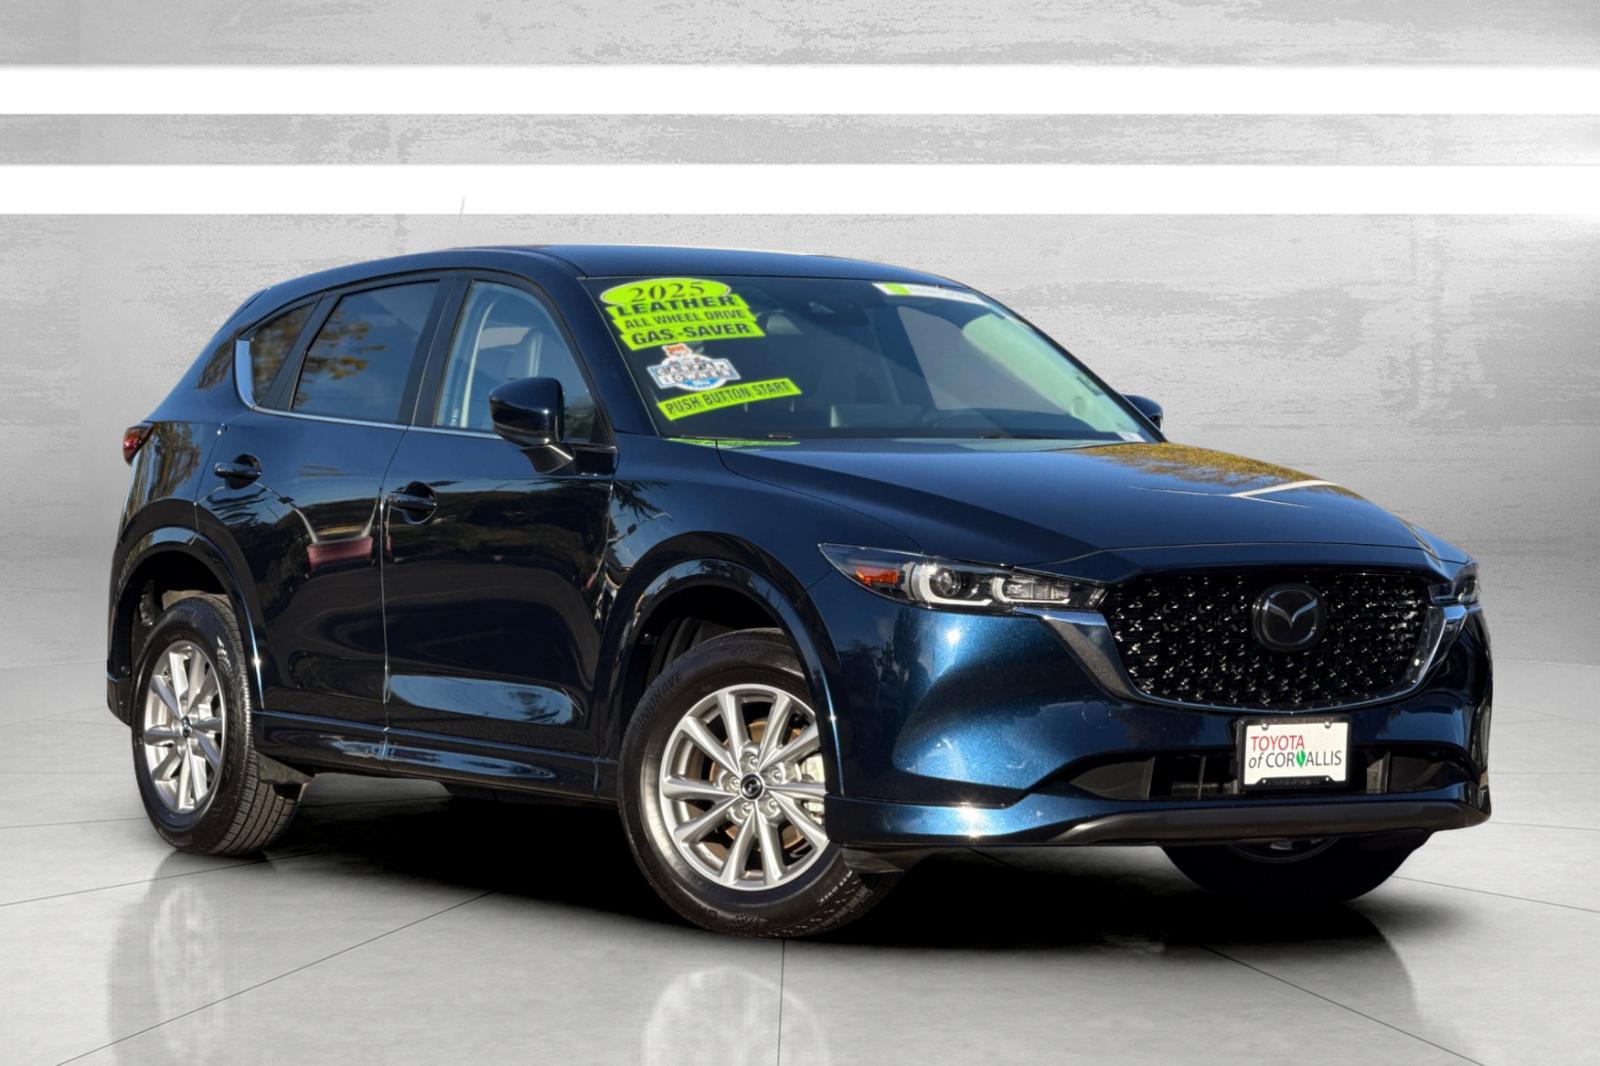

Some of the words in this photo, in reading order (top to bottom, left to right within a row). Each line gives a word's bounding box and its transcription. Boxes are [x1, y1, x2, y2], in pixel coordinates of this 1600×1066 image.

[629, 281, 705, 303] 2025
[618, 295, 736, 317] LEATHER
[625, 317, 651, 330] ALL
[654, 311, 702, 326] WHEEL
[706, 308, 746, 322] DRIVE
[665, 399, 702, 414] PUSH
[703, 388, 752, 406] BUTTON
[753, 381, 791, 397] START
[1250, 734, 1305, 752] TOYOTA
[1248, 752, 1264, 769] of
